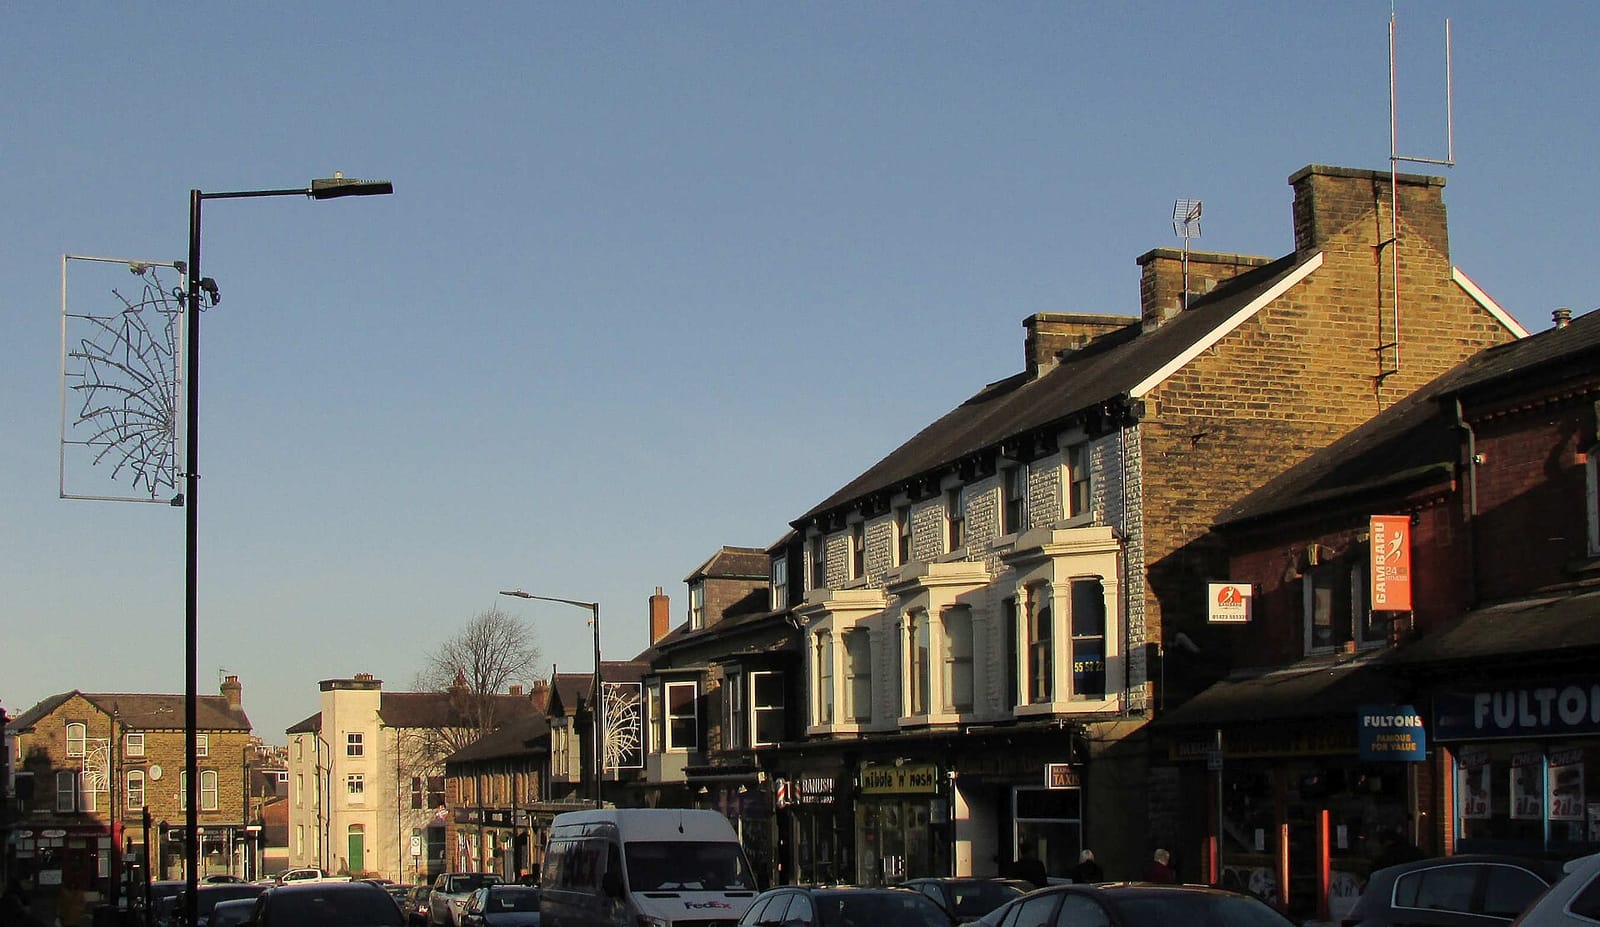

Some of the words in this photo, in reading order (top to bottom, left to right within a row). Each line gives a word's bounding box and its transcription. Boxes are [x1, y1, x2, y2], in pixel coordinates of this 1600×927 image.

[1375, 522, 1387, 604] GAMBARU
[1386, 566, 1397, 576] 24
[1363, 714, 1424, 727] FULTONS
[1376, 733, 1412, 742] FAMOUS
[1371, 742, 1388, 752] FOR
[1390, 742, 1417, 751] VALUE
[865, 771, 893, 788] nibble
[910, 768, 932, 787] nosh
[1053, 774, 1080, 785] TAXIS
[684, 901, 732, 910] FedEx
